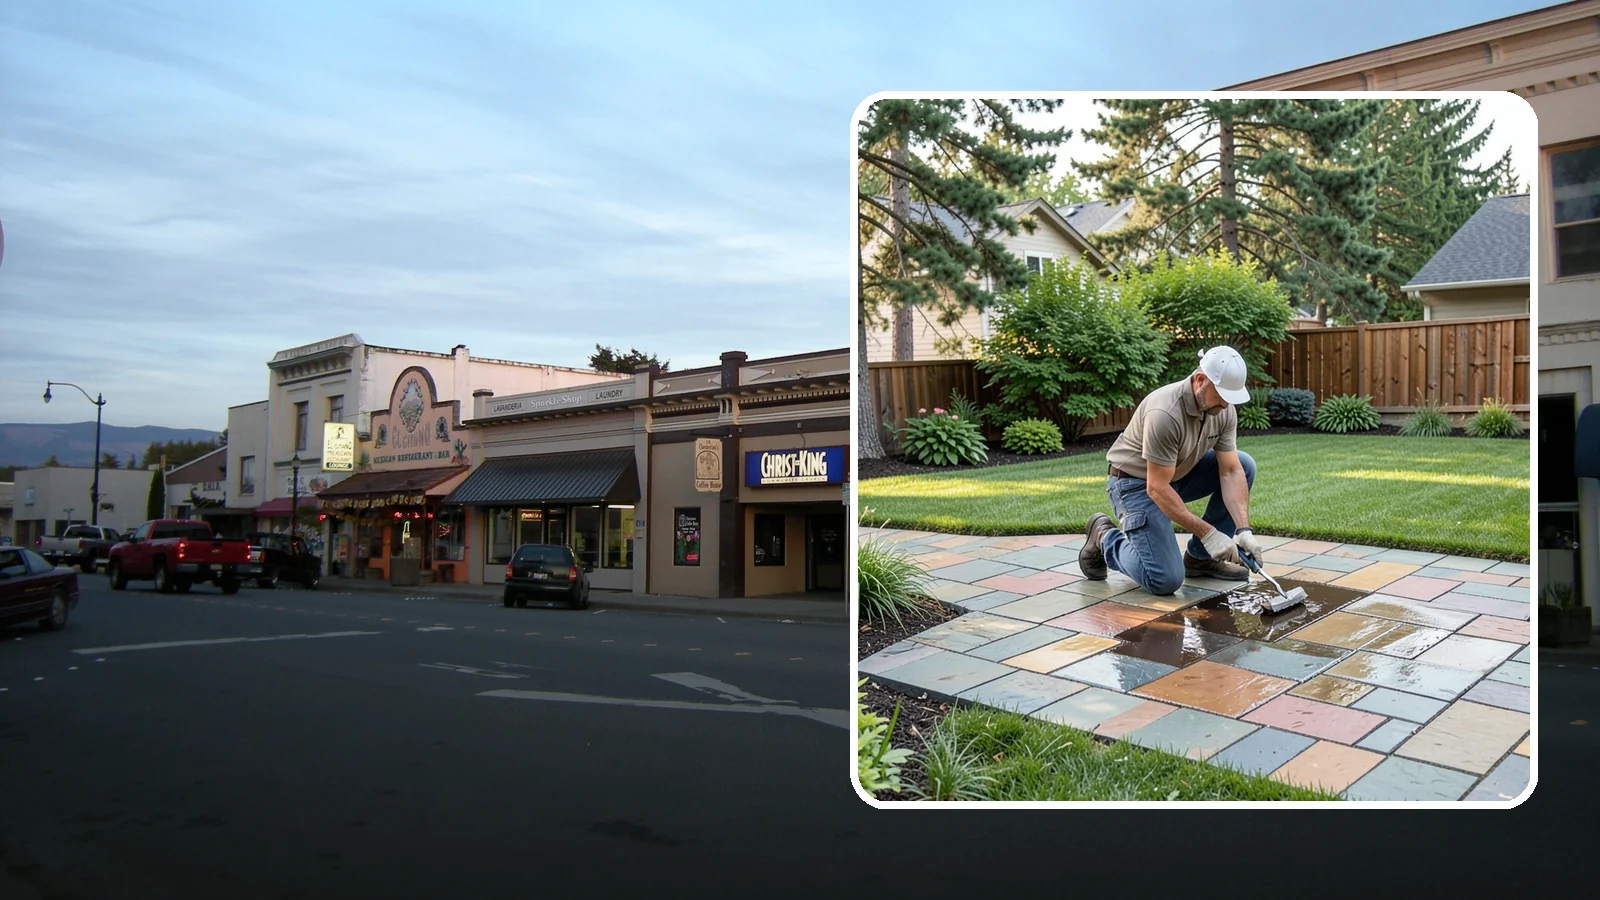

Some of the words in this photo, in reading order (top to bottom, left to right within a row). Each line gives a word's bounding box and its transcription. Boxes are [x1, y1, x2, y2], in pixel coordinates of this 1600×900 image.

[562, 394, 582, 405] Shop
[595, 389, 623, 400] LAUNDRY
[493, 402, 522, 413] LAVANDERIA
[374, 455, 396, 464] MEXICAN
[397, 451, 434, 462] RESTAURANT
[437, 450, 450, 459] BAR
[760, 452, 798, 478] CHRIST
[799, 450, 828, 476] KING
[696, 480, 709, 488] Coffee
